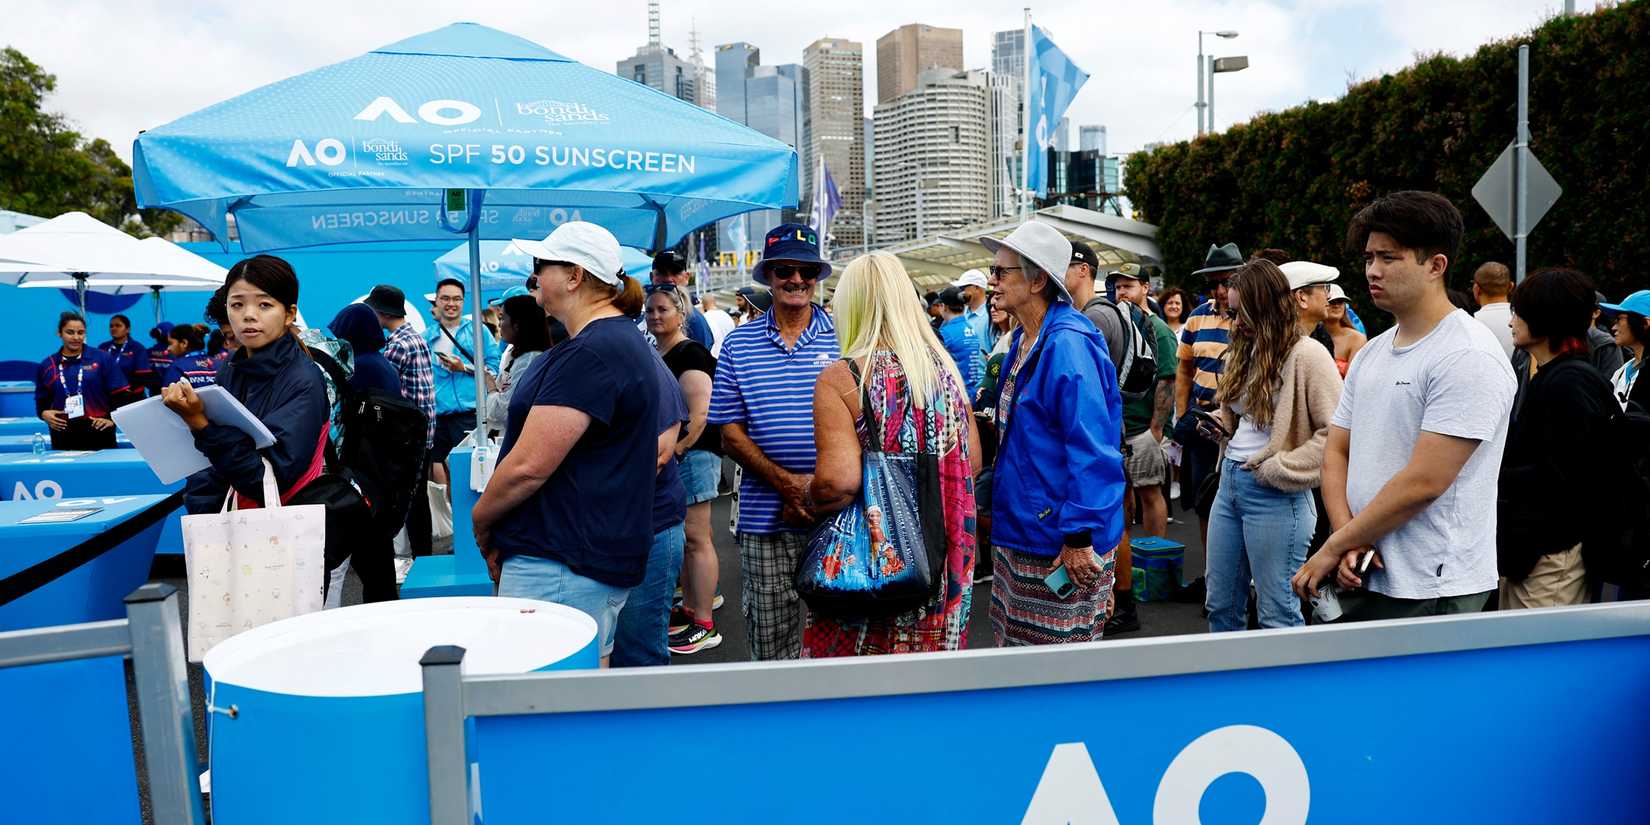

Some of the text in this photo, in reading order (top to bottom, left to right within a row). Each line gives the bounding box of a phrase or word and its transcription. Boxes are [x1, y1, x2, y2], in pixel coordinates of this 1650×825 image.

[353, 96, 482, 126] AO
[516, 100, 590, 117] bondi
[544, 111, 609, 123] sands
[286, 138, 346, 167] AO
[363, 140, 401, 153] bondi
[375, 151, 408, 161] sands
[429, 143, 695, 174] SPF 50 SUNSCREEN
[13, 480, 63, 500] AO
[1021, 724, 1310, 825] AO
